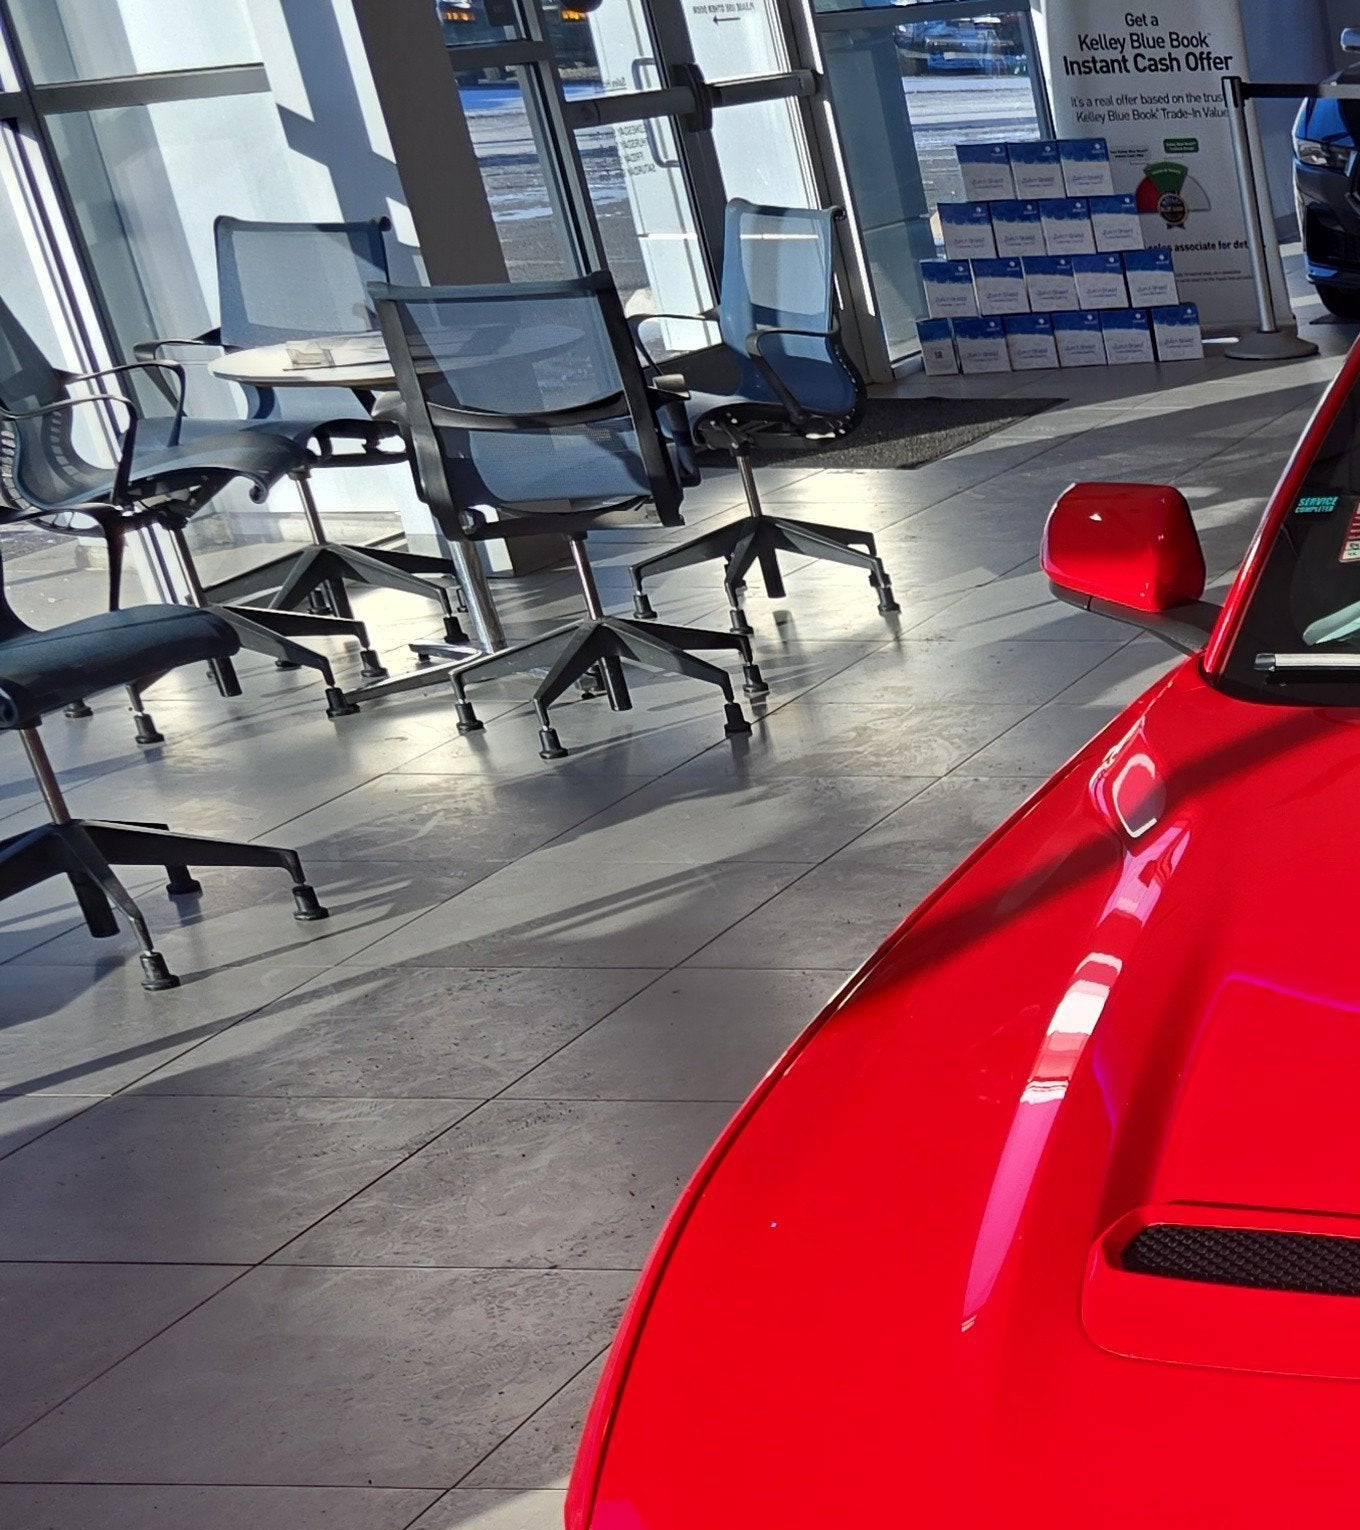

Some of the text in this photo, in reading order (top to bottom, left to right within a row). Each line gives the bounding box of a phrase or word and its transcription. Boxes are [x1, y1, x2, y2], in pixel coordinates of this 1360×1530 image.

[1124, 12, 1159, 27] Get a
[1078, 33, 1126, 54] Kelley
[1129, 32, 1165, 49] Blue
[1063, 51, 1233, 76] Instant Cash Offer
[1086, 98, 1093, 107] a
[1094, 94, 1114, 107] real
[1116, 93, 1138, 106] offer
[1140, 92, 1170, 105] based
[1171, 95, 1184, 104] on
[1185, 92, 1202, 104] the
[1202, 92, 1223, 103] trus
[1076, 110, 1106, 125] Kelley
[1108, 109, 1130, 122] Blue
[1161, 107, 1201, 119] Trade-In
[1174, 241, 1217, 252] associate
[1218, 240, 1230, 250] for
[1298, 496, 1339, 507] SERVICE
